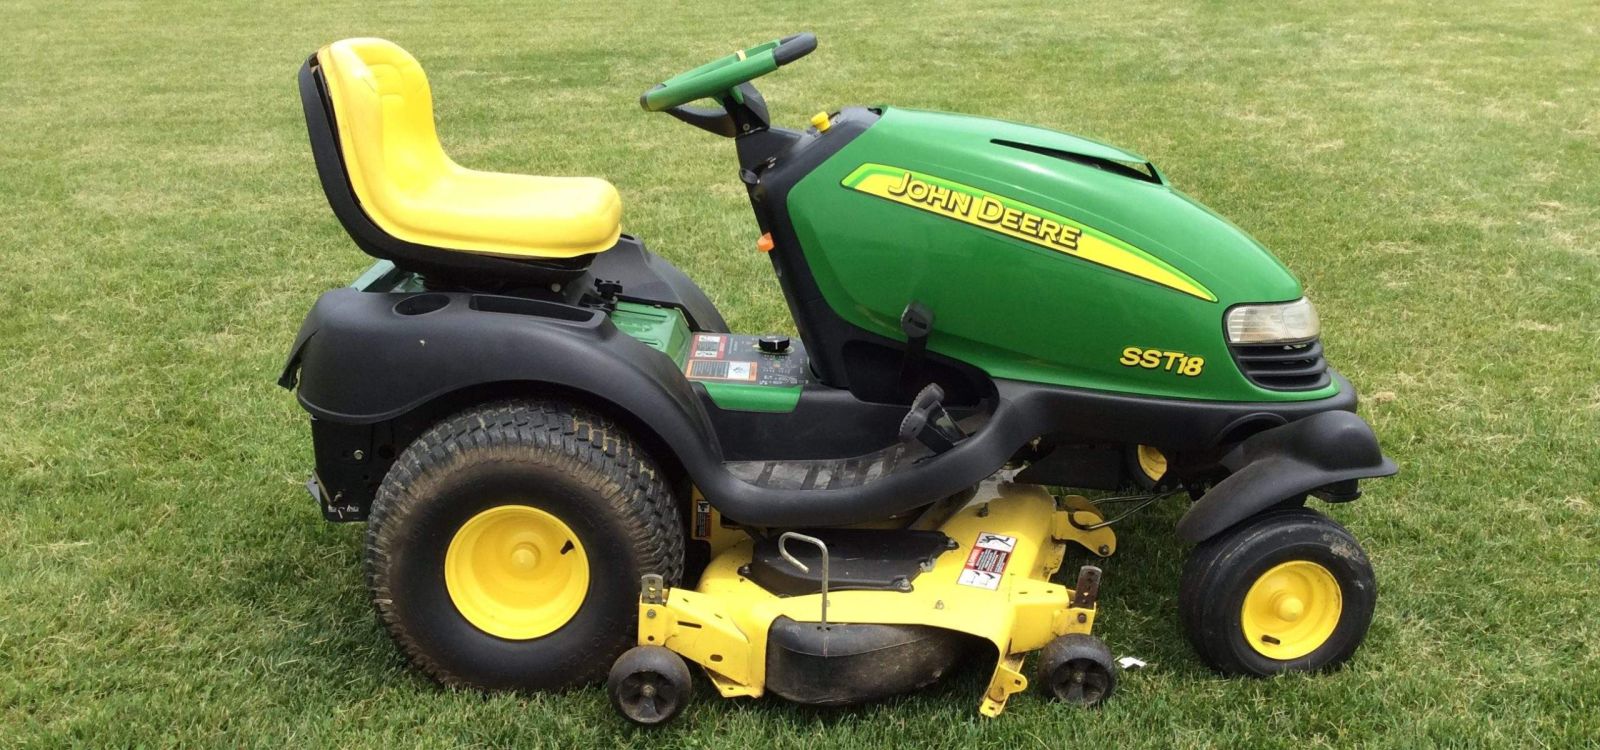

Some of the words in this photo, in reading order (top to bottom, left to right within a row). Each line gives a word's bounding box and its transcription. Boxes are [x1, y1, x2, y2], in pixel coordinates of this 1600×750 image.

[888, 171, 972, 216] JOHN
[977, 195, 1081, 250] DEERE
[1119, 346, 1205, 377] SST18
